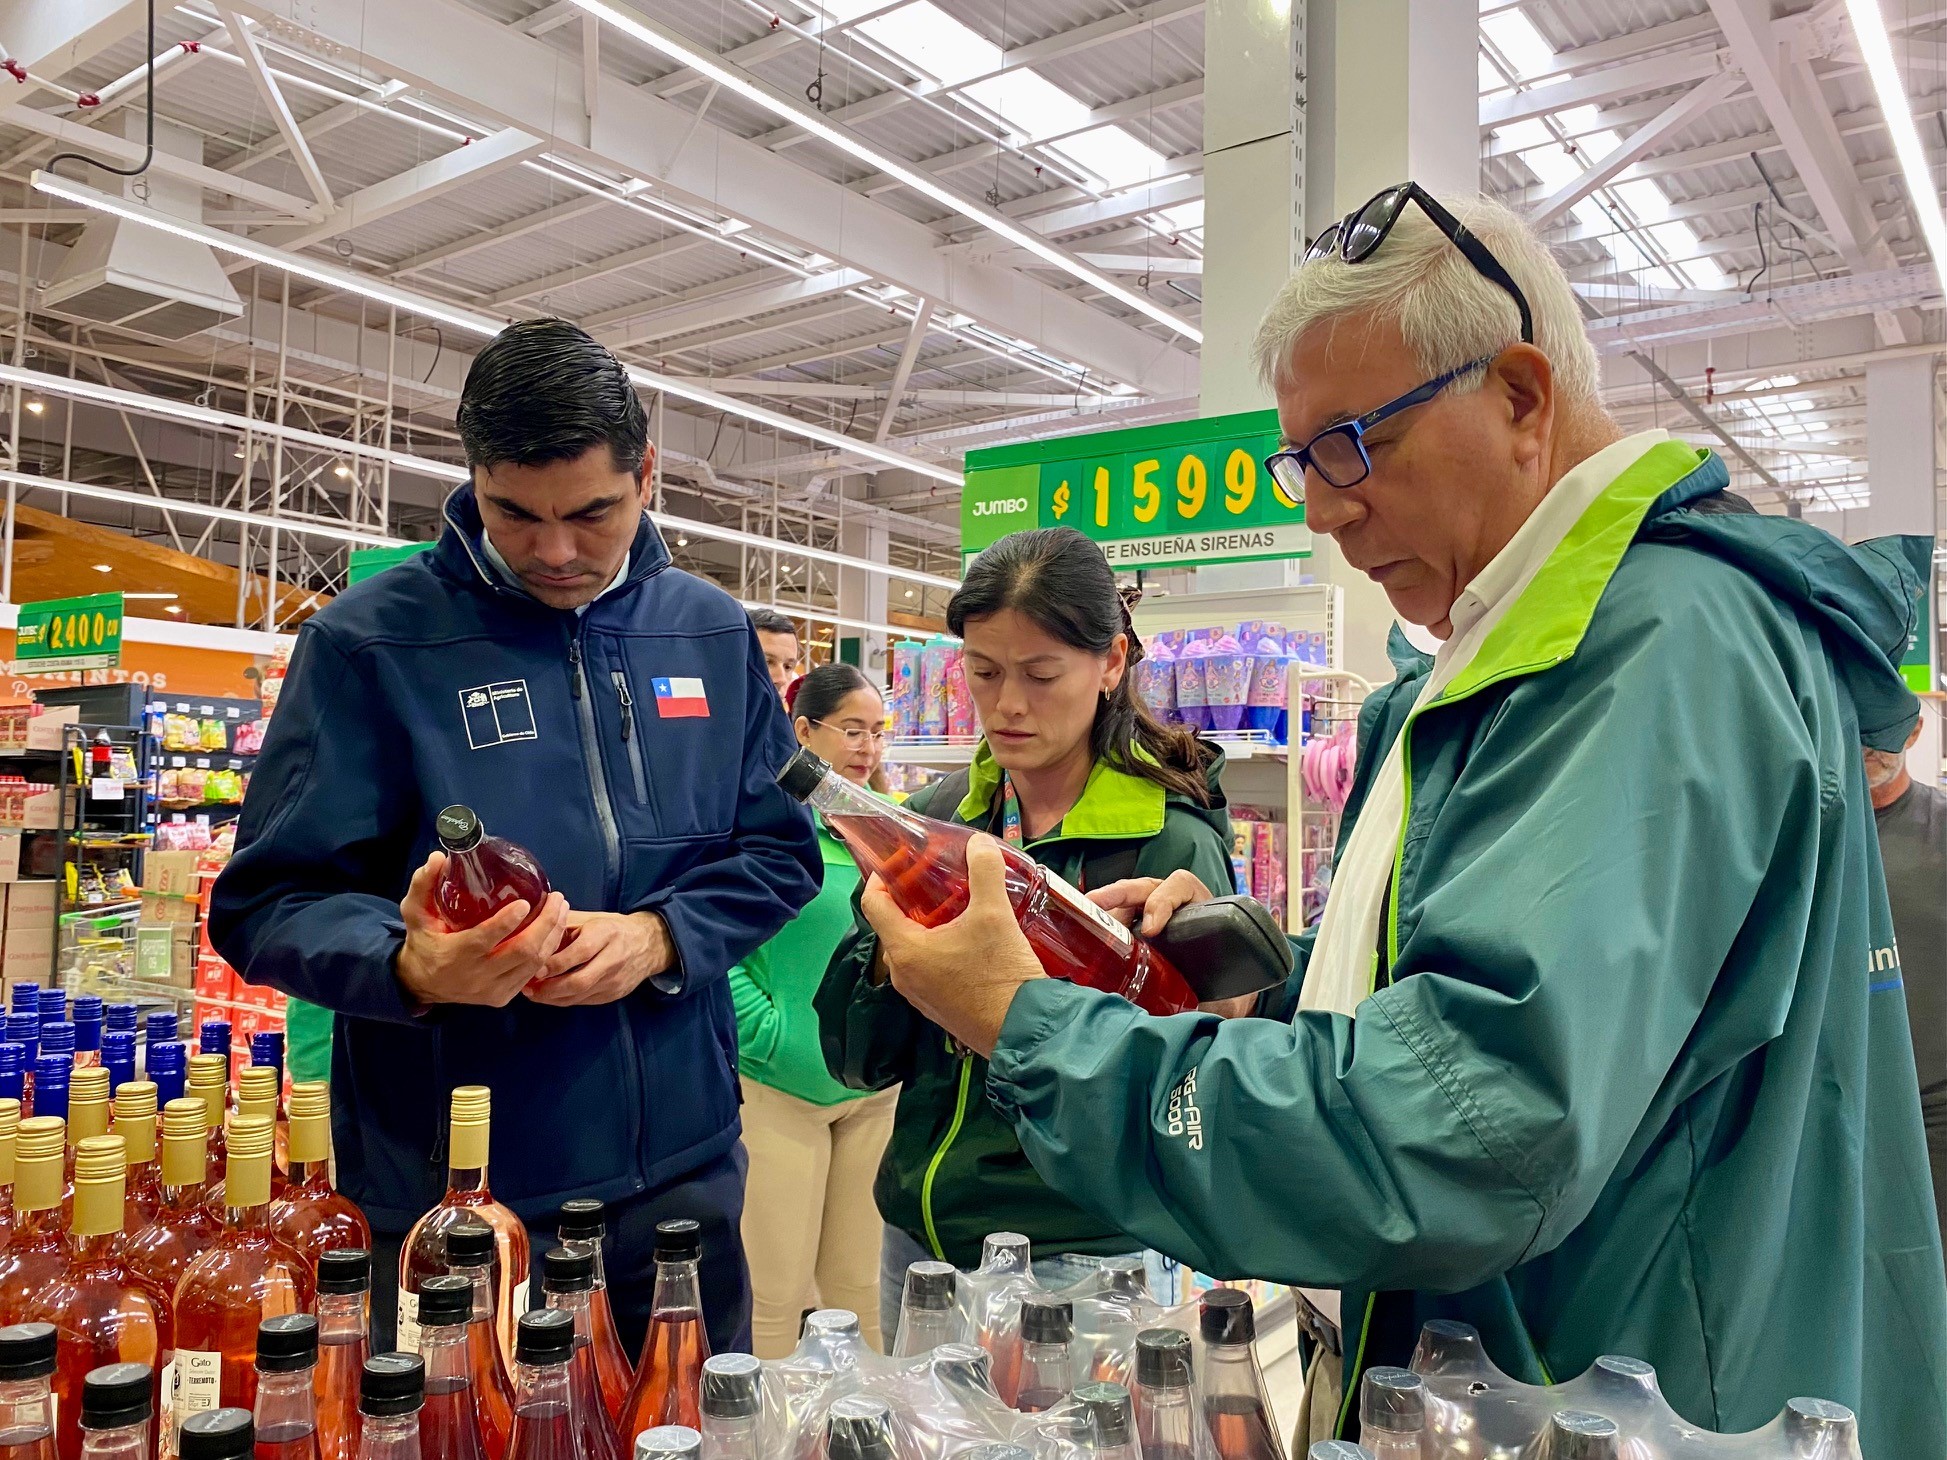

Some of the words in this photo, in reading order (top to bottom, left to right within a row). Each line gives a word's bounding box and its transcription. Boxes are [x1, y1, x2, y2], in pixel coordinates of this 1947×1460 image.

[973, 498, 1028, 516] JUMBO
[1120, 537, 1196, 558] ENSUEÑA
[1200, 532, 1275, 552] SIRENAS
[1007, 815, 1017, 838] SAG
[1168, 1085, 1183, 1135] 5000
[1184, 1066, 1203, 1150] RG-AIR
[191, 1357, 211, 1367] Gato
